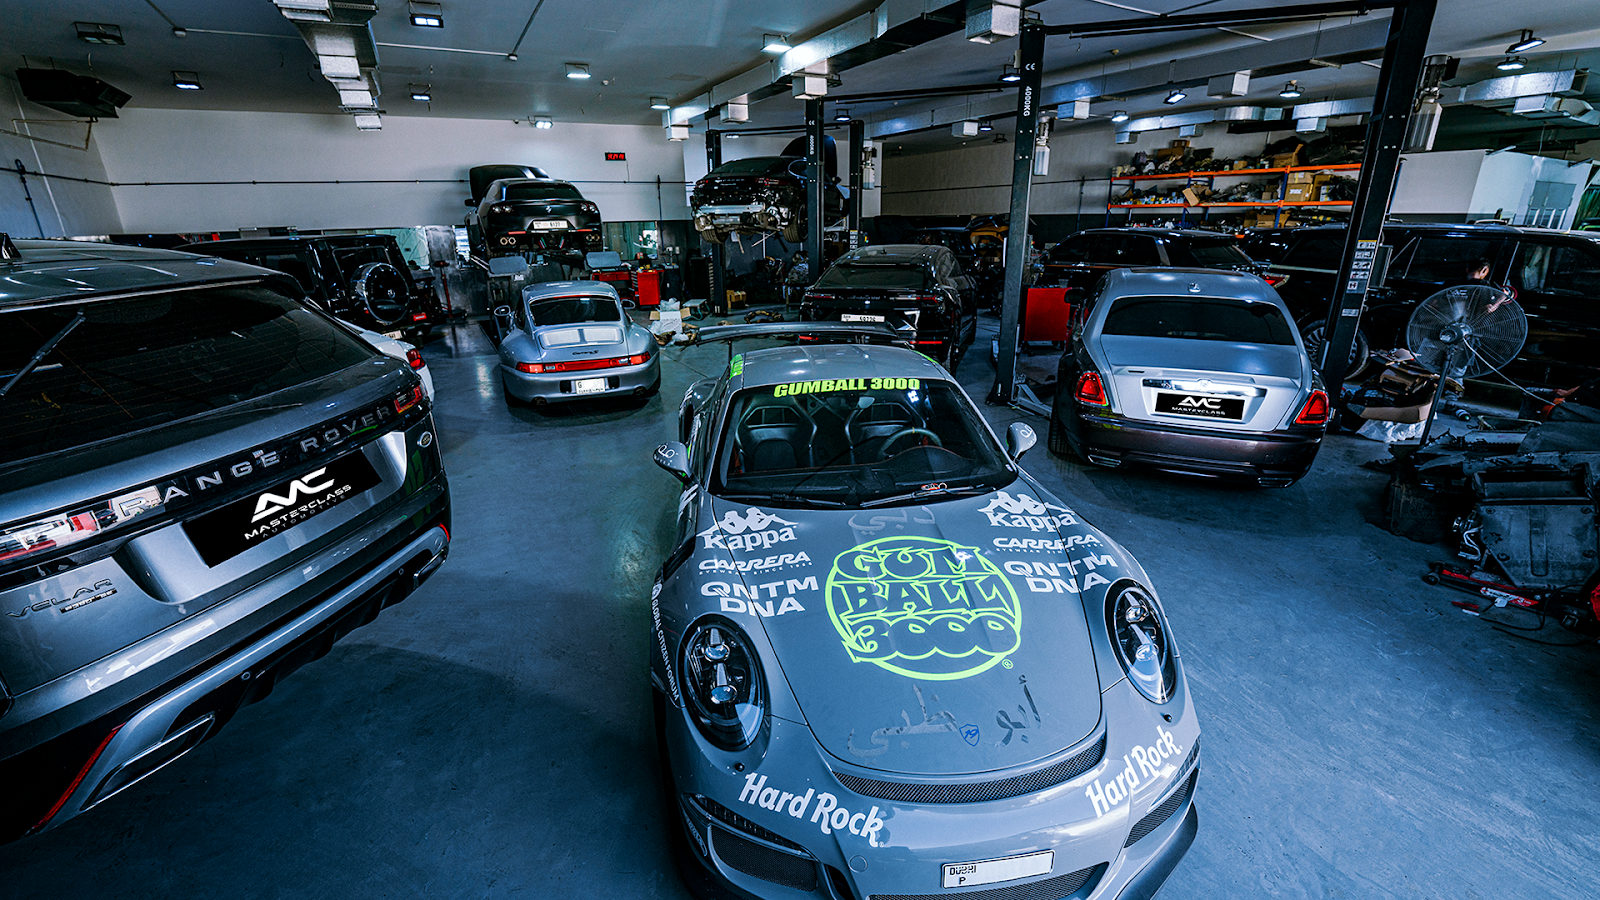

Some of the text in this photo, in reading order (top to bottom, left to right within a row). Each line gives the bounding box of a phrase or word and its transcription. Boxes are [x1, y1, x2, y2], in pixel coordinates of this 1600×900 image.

[1023, 86, 1032, 116] 4000KG
[773, 378, 920, 398] GUMBALL 3000
[1171, 406, 1226, 416] MASTERCLASS
[119, 405, 392, 517] RANGE ROVER
[244, 484, 351, 540] MASTERCLASS
[263, 494, 345, 538] AUTOMOTIVE
[848, 506, 936, 535] دبي
[986, 511, 1080, 532] Kappa
[703, 527, 797, 552] Kappa
[993, 534, 1101, 550] CARRERA
[698, 551, 811, 572] CARRERA
[1003, 554, 1118, 577] QNTM
[701, 576, 819, 600] QNTM
[832, 574, 1016, 617] BALL
[1025, 572, 1111, 593] DNA
[5, 579, 113, 618] VELAR
[720, 597, 806, 617] DNA
[652, 599, 680, 701] GLOBAL CITIZEN FORUM
[841, 613, 1021, 663] 3000
[1085, 725, 1181, 819] Hard Rock
[738, 772, 884, 848] Hard Rock
[958, 876, 967, 885] P
